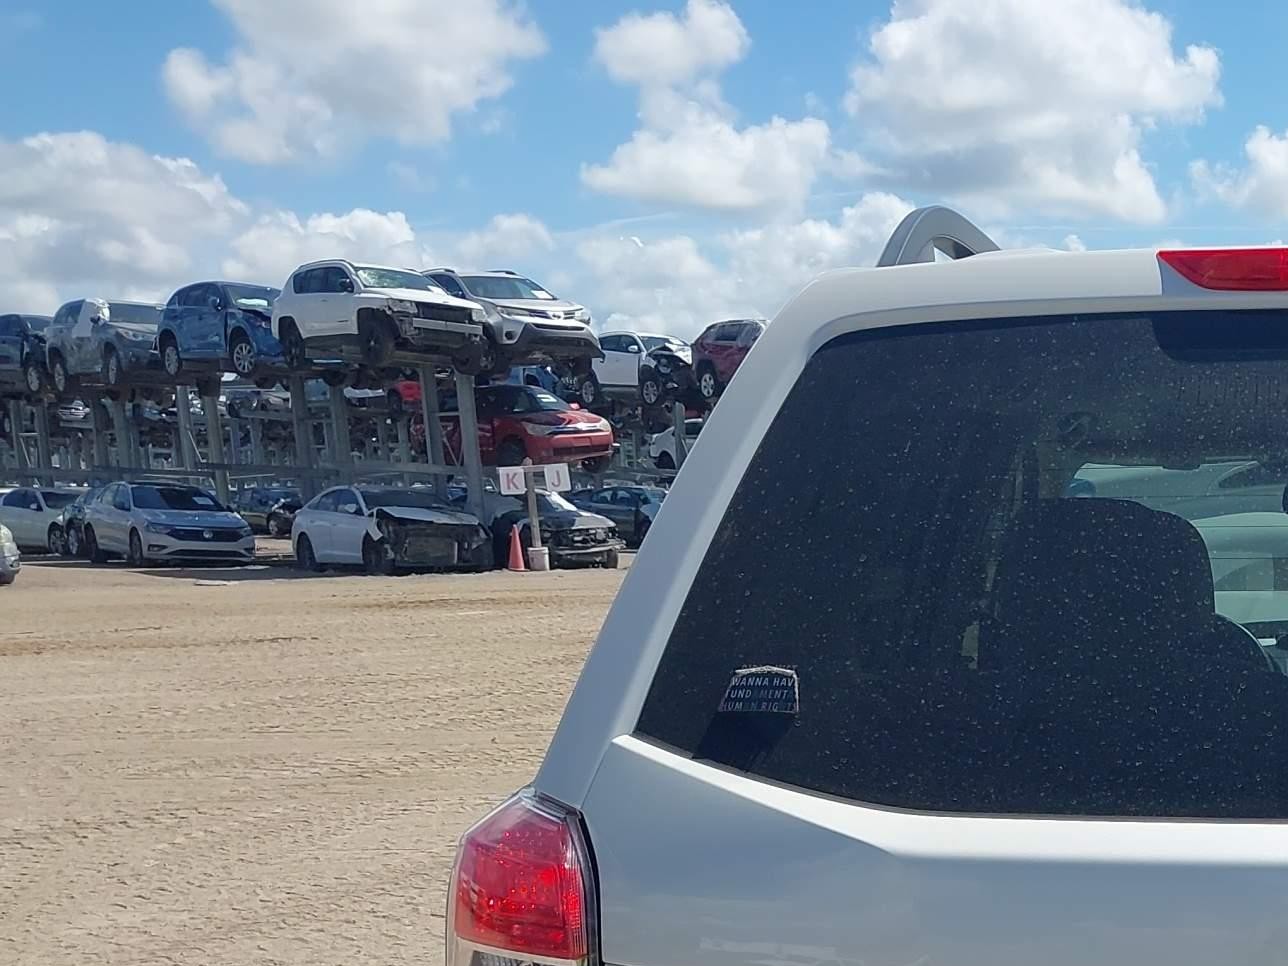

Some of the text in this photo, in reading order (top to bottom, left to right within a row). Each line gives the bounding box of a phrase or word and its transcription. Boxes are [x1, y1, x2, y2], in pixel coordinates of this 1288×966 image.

[505, 472, 519, 490] K
[551, 469, 561, 487] J
[731, 677, 769, 687] WANNA
